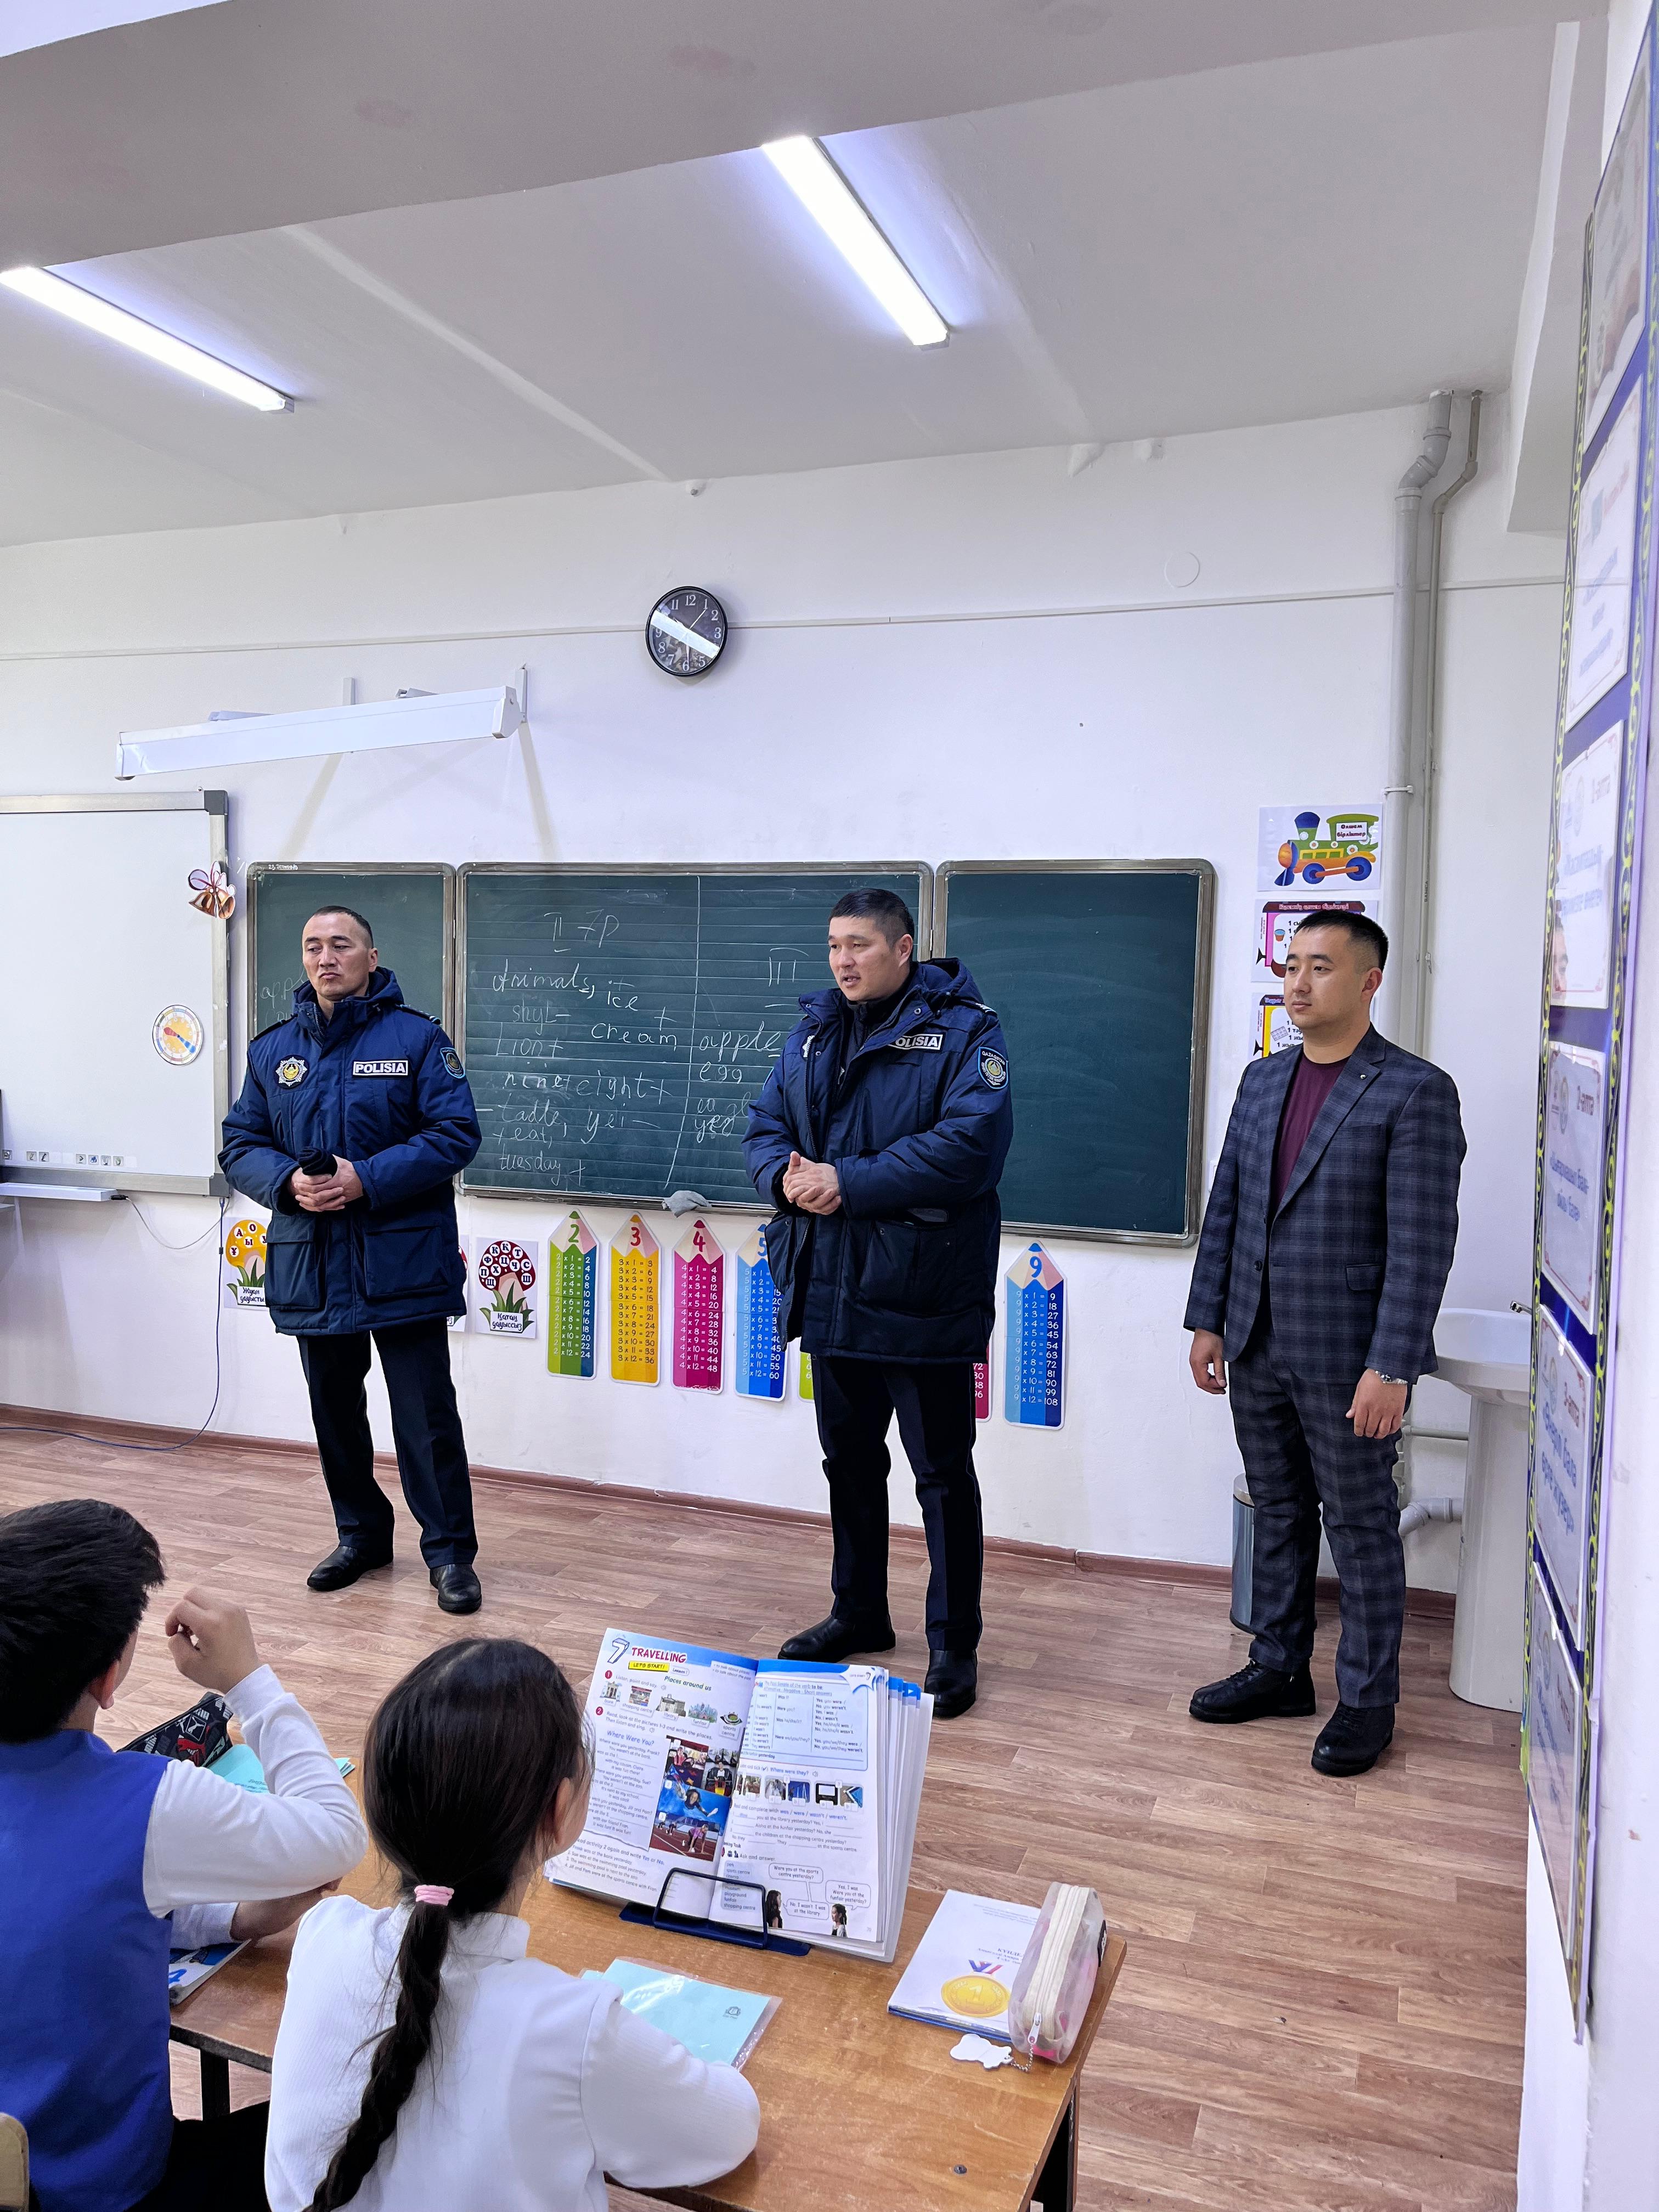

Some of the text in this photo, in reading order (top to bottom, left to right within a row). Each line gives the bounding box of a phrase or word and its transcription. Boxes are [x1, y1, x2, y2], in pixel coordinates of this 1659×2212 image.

[672, 600, 679, 610] 11
[685, 595, 696, 606] 12
[704, 599, 708, 610] 1
[712, 610, 718, 620] 2
[656, 628, 662, 637] 9
[715, 628, 721, 638] 3
[658, 642, 665, 653] 8
[668, 654, 674, 665] 7
[698, 656, 706, 667] 5
[682, 661, 689, 671] 6
[895, 1036, 938, 1047] OLISIA
[354, 1062, 407, 1074] POLISIA
[568, 1224, 579, 1243] 2
[630, 1227, 641, 1246] 3
[693, 1231, 706, 1252] 4
[758, 1237, 767, 1257] 5
[1030, 1256, 1042, 1278] 9
[607, 1638, 630, 1663] 7
[631, 1647, 686, 1663] TRAVELLING
[664, 1675, 681, 1685] Places
[683, 1679, 703, 1689] around
[622, 1702, 639, 1712] shopping
[663, 1712, 677, 1720] library
[642, 1719, 658, 1728] pictures
[696, 1731, 713, 1740] places.
[607, 1730, 654, 1746] Where Were You?
